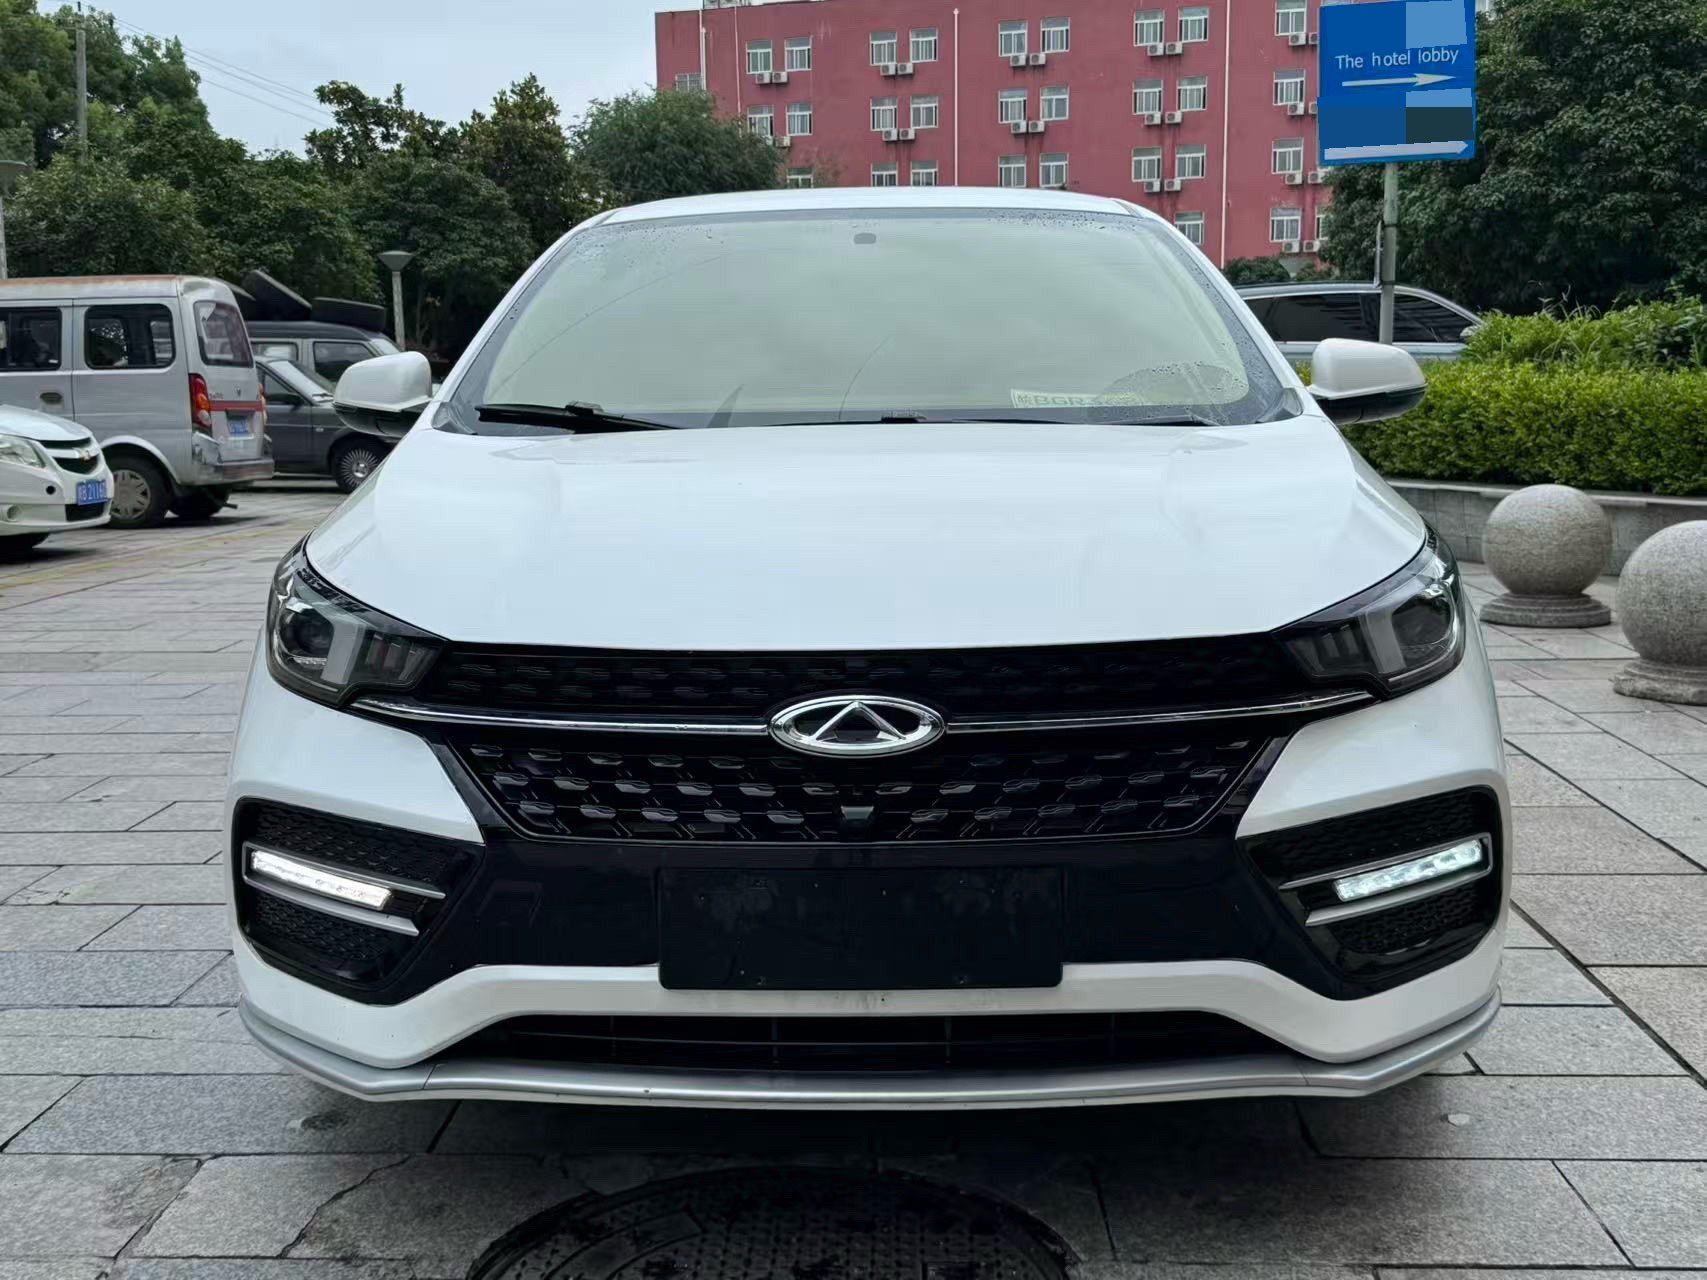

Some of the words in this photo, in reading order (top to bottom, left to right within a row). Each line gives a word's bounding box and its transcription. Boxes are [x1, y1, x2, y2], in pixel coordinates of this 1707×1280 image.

[1334, 54, 1364, 71] The
[1372, 50, 1411, 67] hotel
[1418, 47, 1459, 64] lobby
